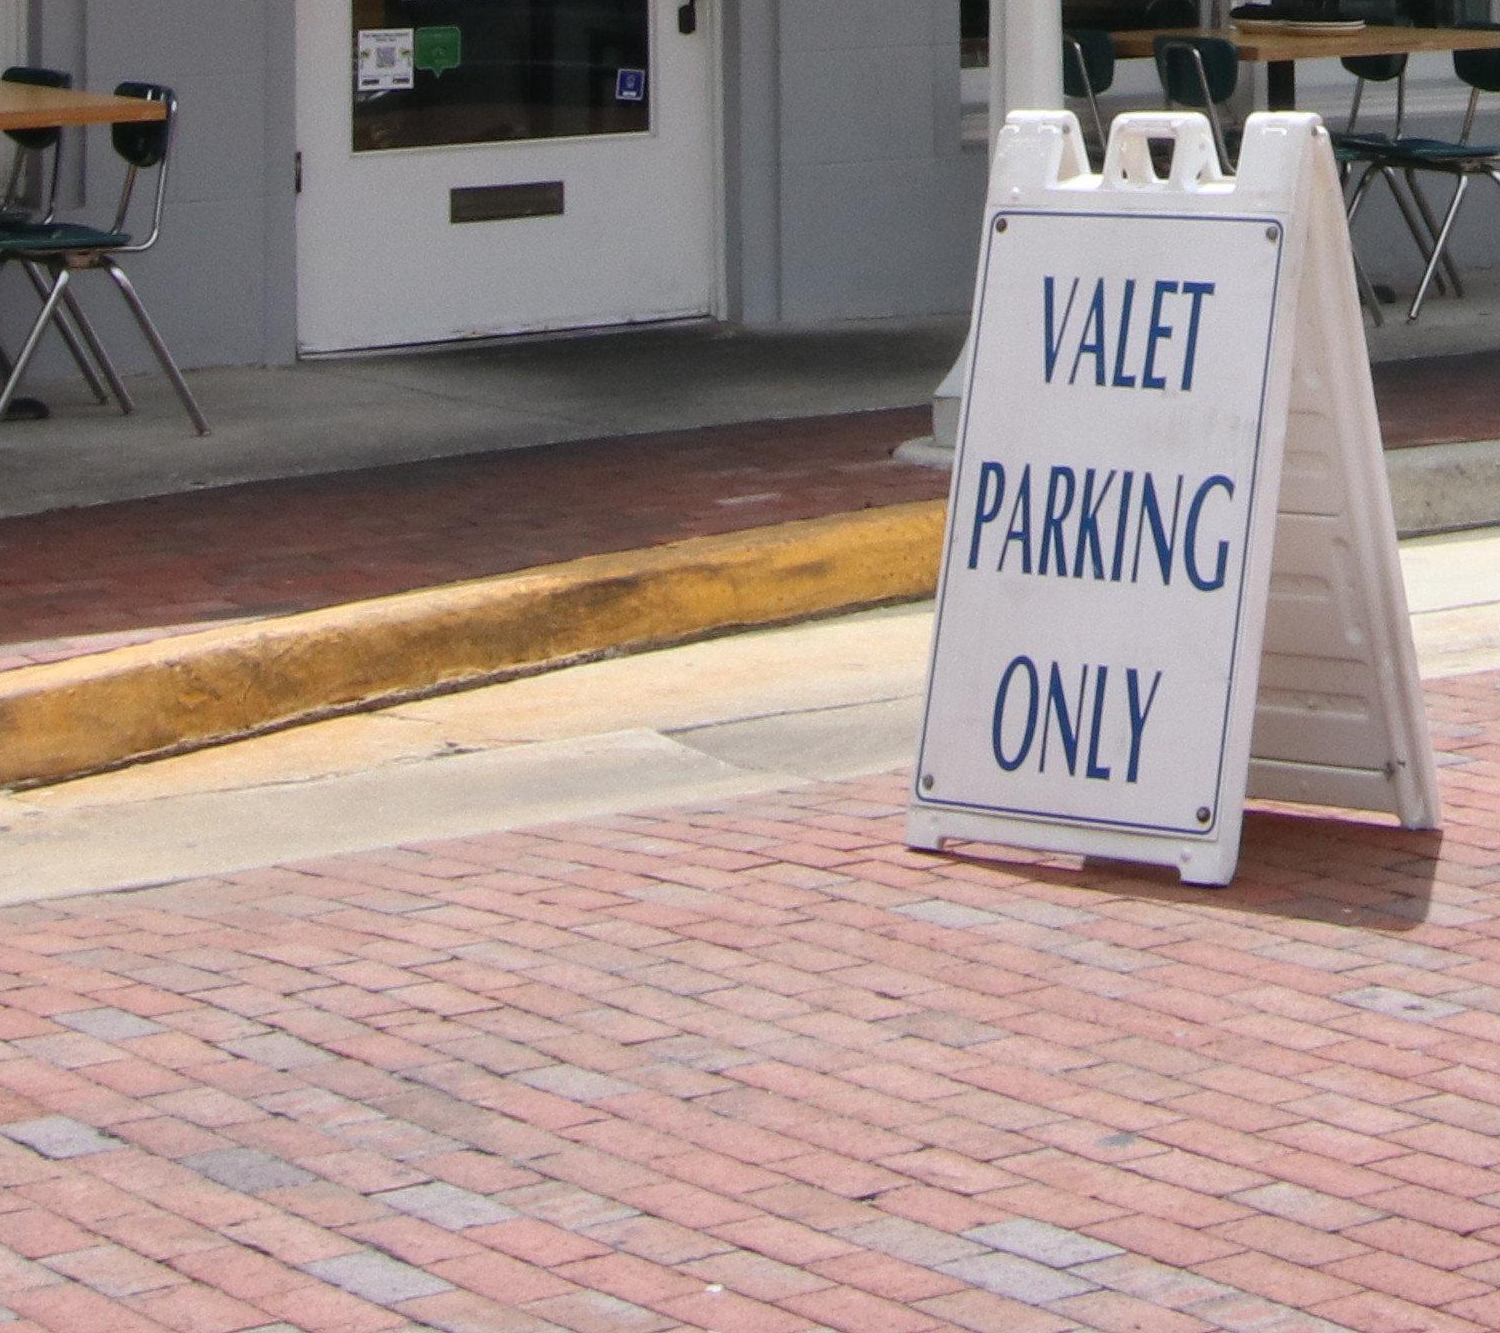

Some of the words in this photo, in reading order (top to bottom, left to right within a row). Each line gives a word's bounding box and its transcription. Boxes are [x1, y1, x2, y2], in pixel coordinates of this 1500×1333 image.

[1042, 275, 1216, 393] VALET
[966, 460, 1235, 593] PARKING
[991, 654, 1162, 784] ONLY
